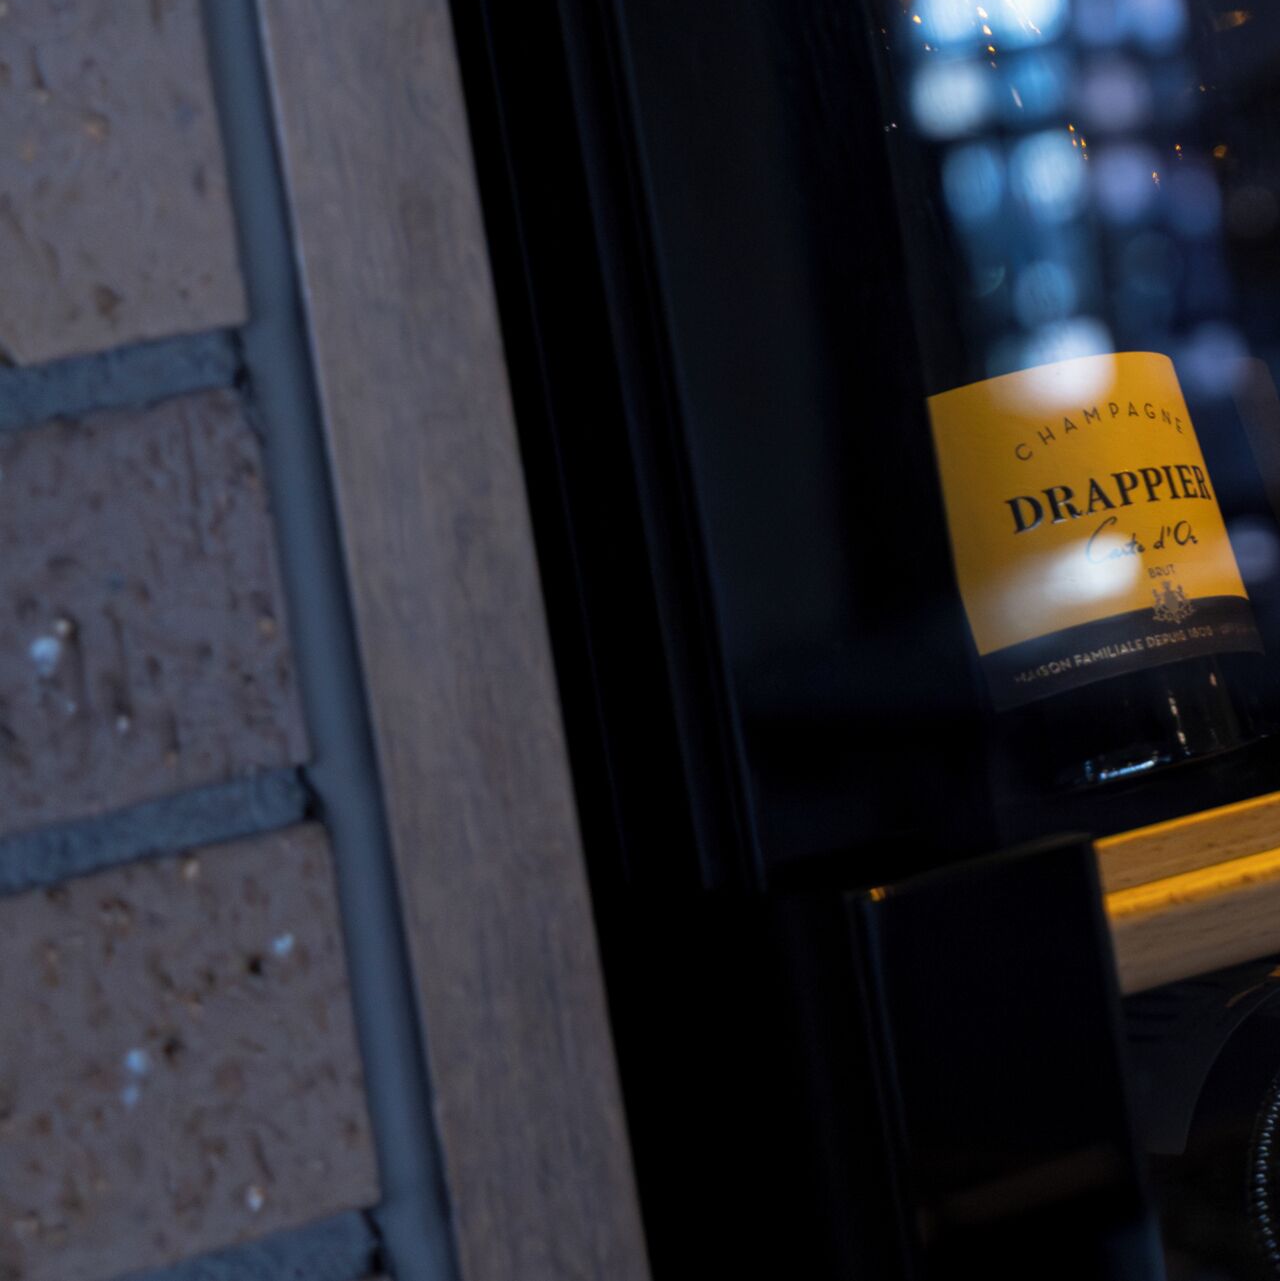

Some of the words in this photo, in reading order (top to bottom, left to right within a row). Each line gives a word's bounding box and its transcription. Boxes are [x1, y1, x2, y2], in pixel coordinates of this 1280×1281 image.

[1014, 400, 1184, 462] CHAMPAGNE
[1003, 463, 1213, 535] DRAPPIER
[1147, 563, 1177, 579] BRUT
[1072, 637, 1145, 669] FAMILIALE
[1145, 629, 1188, 649] DEPUIS
